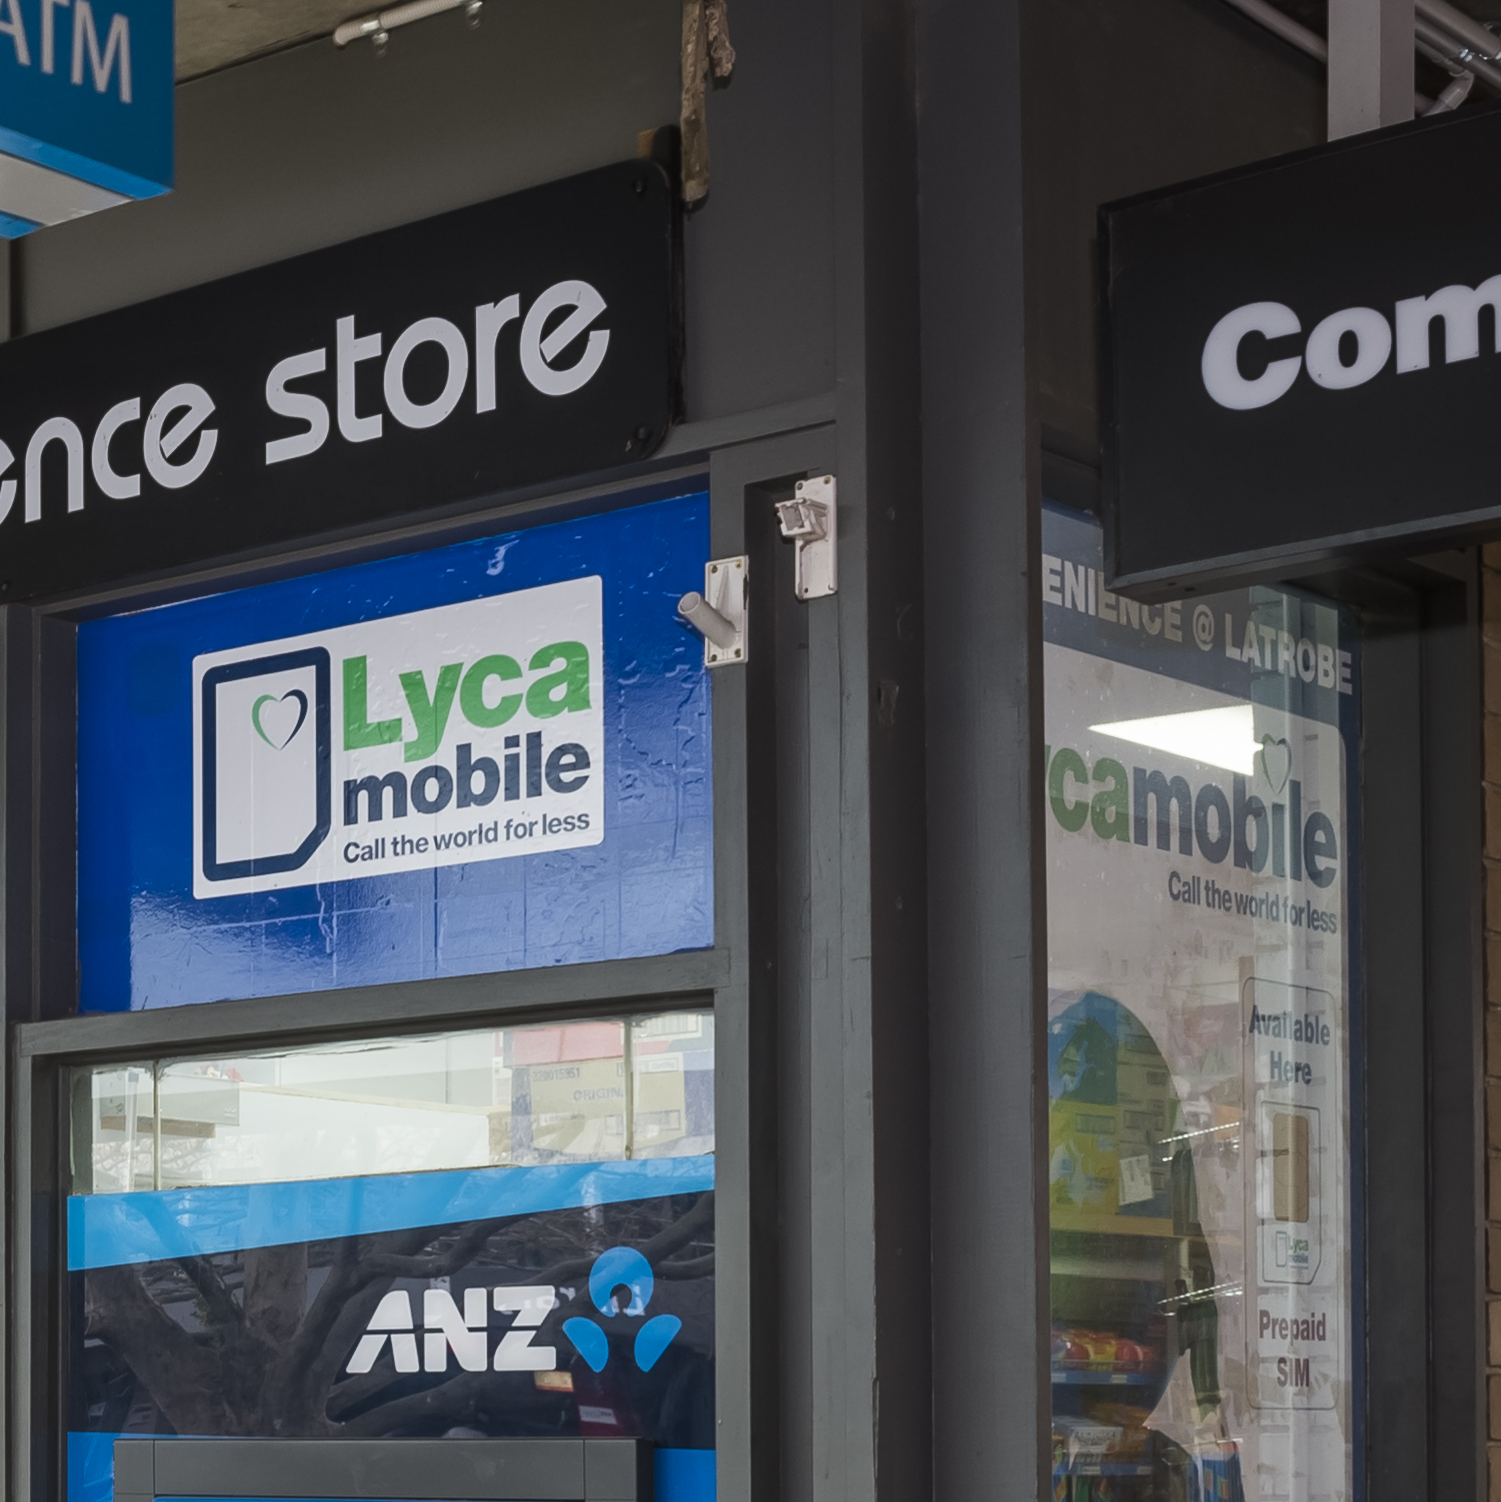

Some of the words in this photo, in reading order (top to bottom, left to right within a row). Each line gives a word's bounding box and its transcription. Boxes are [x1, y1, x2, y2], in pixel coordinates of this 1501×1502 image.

[263, 278, 610, 466] store
[1193, 605, 1215, 651] @
[1225, 612, 1352, 696] LATROBE
[342, 641, 591, 762] Lyca
[342, 730, 591, 825] mobile
[342, 838, 386, 865] Call
[390, 834, 429, 857] the
[432, 822, 497, 851] world
[504, 817, 538, 842] for
[542, 812, 590, 836] less
[1045, 745, 1338, 888] camobile
[1168, 871, 1201, 905] Call
[1205, 881, 1231, 913] the
[1233, 889, 1279, 923] world
[1282, 899, 1304, 928] for
[1306, 901, 1337, 934] less
[1249, 1005, 1331, 1047] Available
[1269, 1050, 1312, 1086] Here
[345, 1285, 557, 1373] ANZ
[1259, 1310, 1327, 1343] Prepaid
[1277, 1358, 1310, 1387] SIM
